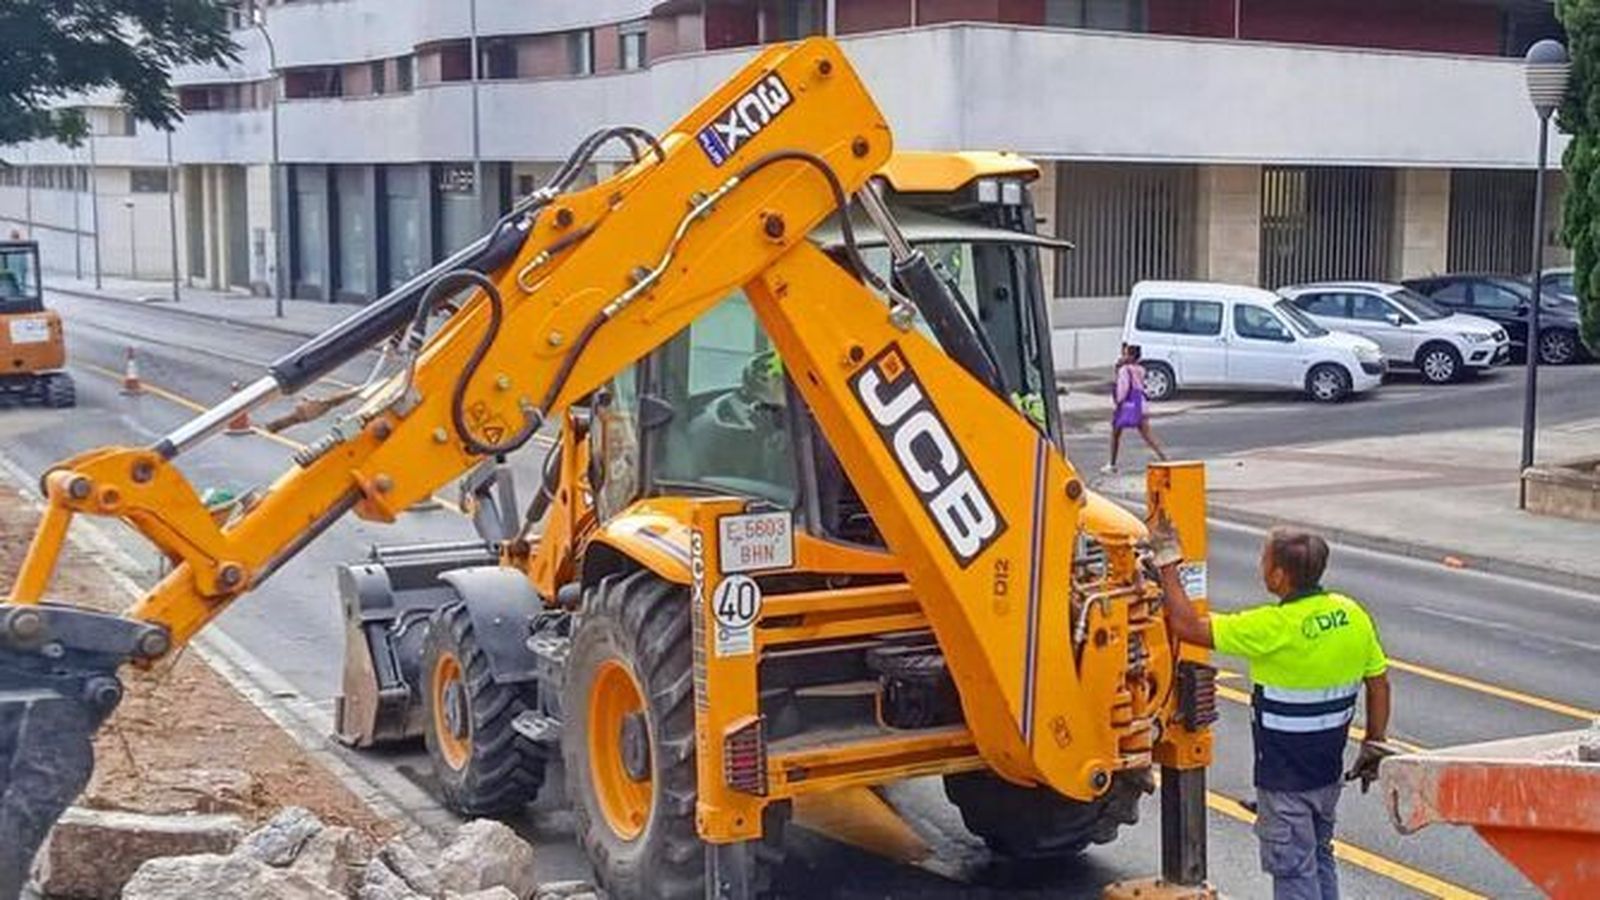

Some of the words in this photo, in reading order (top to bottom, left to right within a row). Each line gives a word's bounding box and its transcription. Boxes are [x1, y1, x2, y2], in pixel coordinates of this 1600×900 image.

[713, 76, 791, 152] 3CX
[858, 368, 997, 557] JCB
[741, 545, 775, 563] BHN
[719, 581, 755, 622] 40
